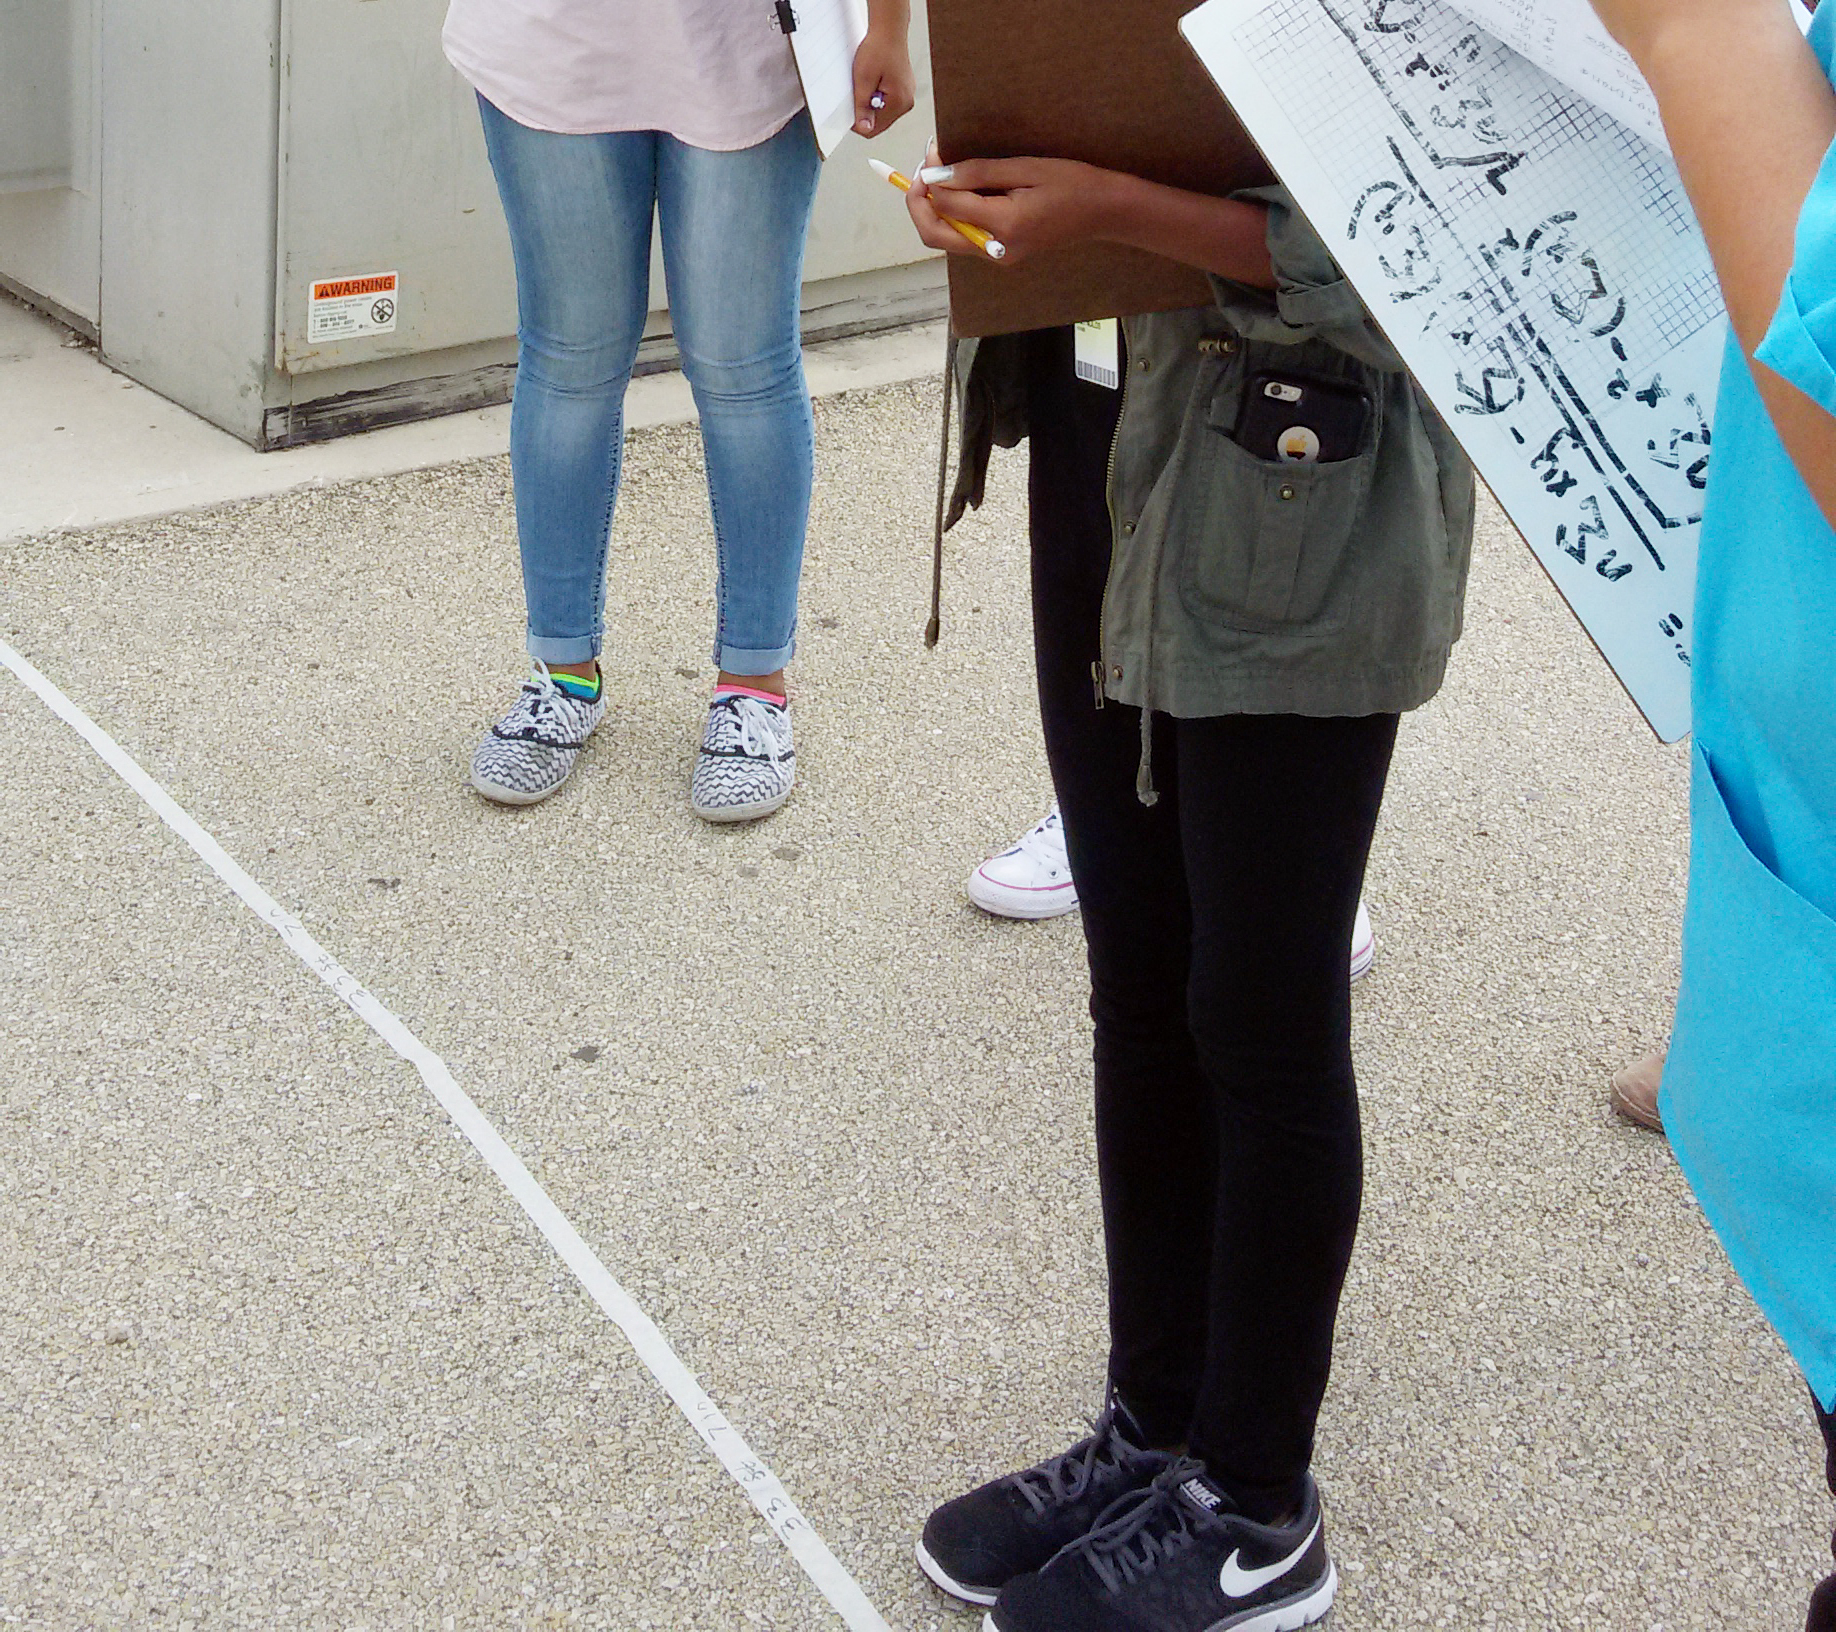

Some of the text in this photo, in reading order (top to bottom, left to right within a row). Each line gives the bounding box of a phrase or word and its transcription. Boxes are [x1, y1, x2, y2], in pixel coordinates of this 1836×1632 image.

[331, 277, 392, 295] WARNING
[707, 1426, 728, 1441] 7
[1185, 1478, 1221, 1509] NIKE
[765, 1496, 809, 1541] 33
